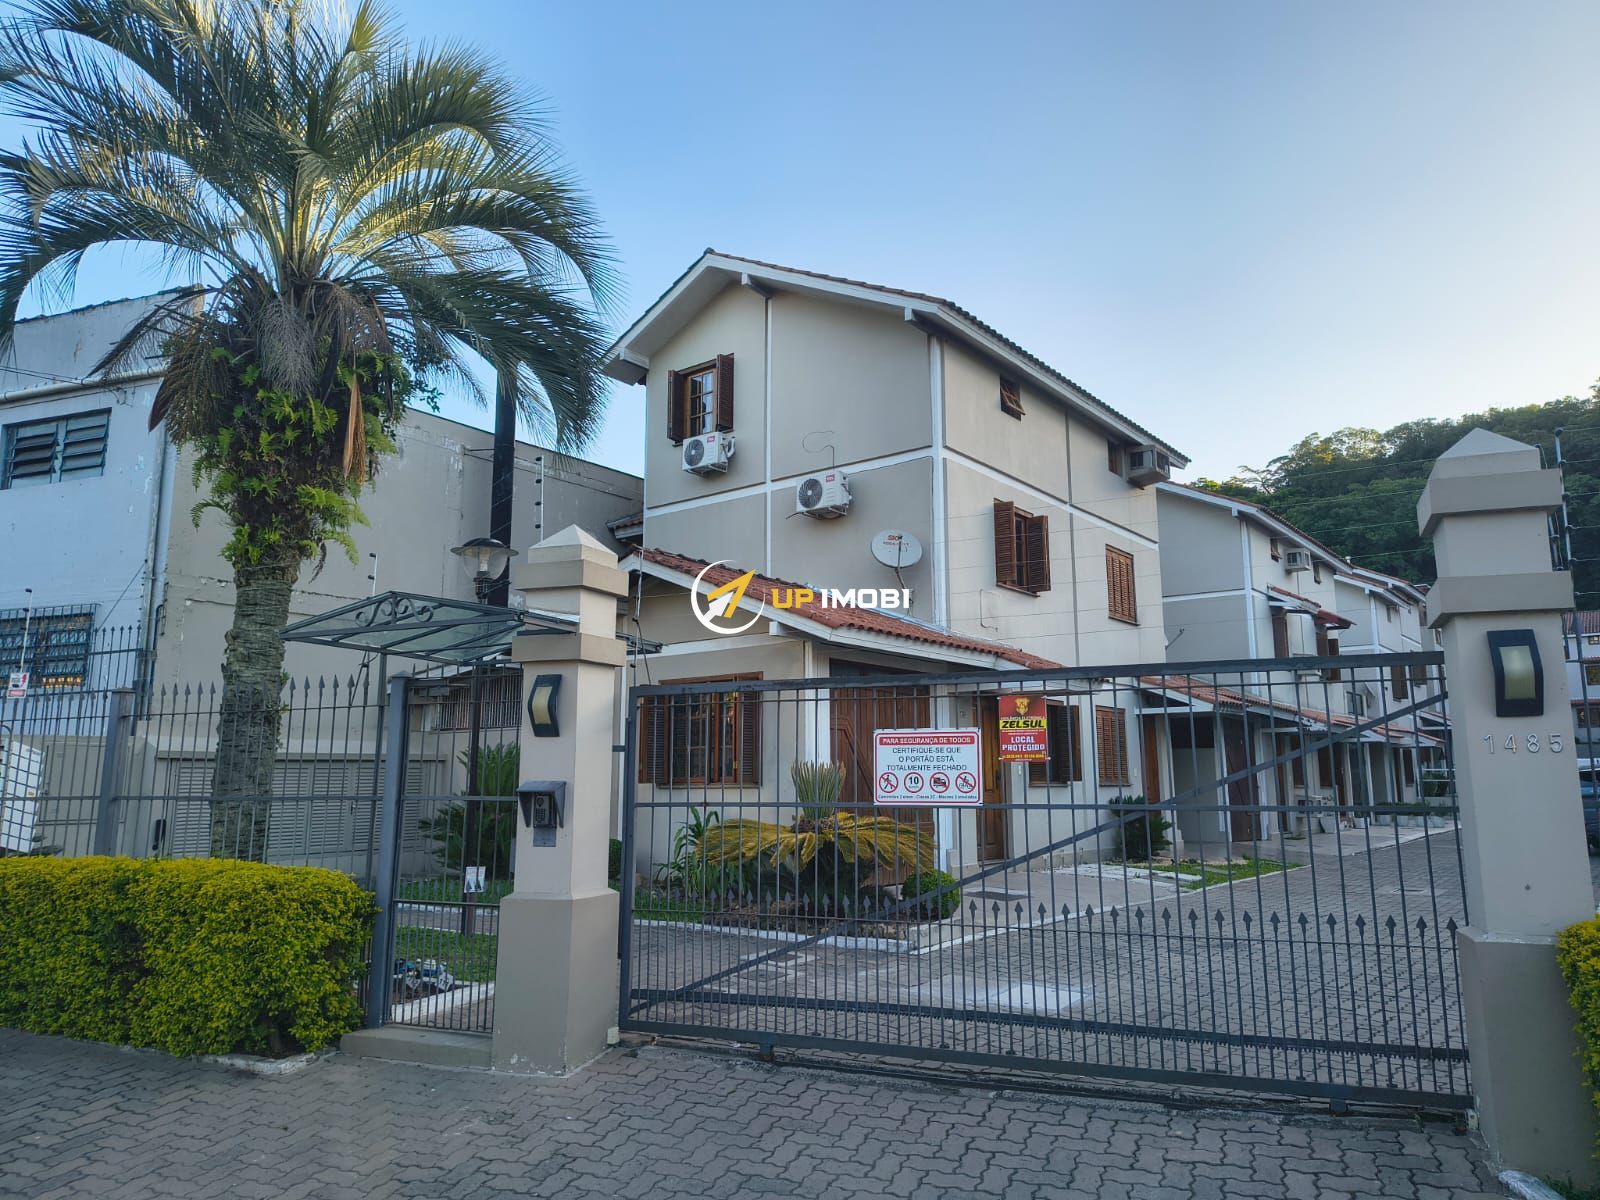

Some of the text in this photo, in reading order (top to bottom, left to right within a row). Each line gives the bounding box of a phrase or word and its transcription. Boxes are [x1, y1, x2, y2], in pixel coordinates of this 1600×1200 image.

[1001, 720, 1044, 728] ZELSUL
[900, 737, 938, 745] SEGURANÇA
[1010, 736, 1036, 744] LOCAL
[1484, 733, 1563, 753] 1485
[908, 776, 919, 785] 10
